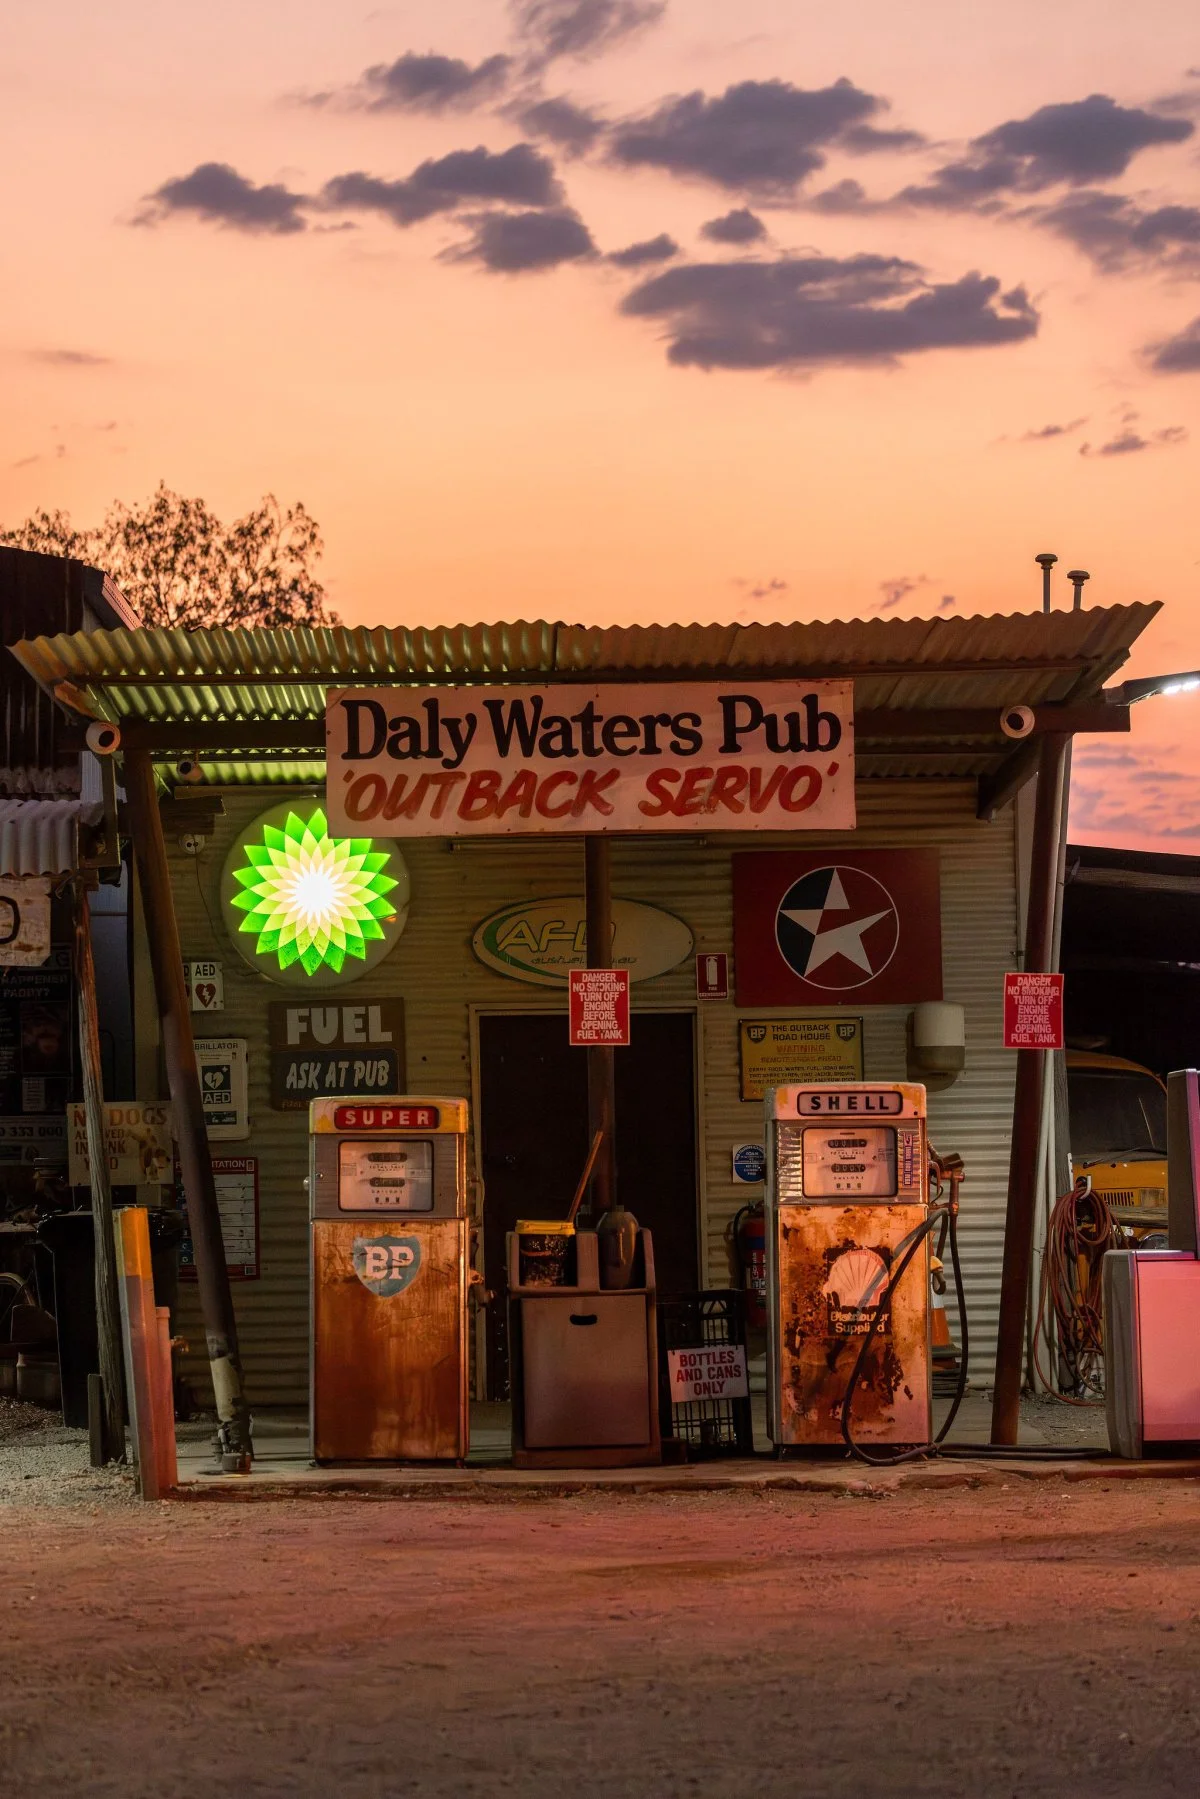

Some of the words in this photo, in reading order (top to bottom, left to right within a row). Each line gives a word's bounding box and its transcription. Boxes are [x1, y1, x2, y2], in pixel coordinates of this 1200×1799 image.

[340, 698, 477, 769] Daly
[483, 696, 703, 758] Waters
[718, 694, 842, 754] Pub
[342, 768, 620, 821] 'OUTBACK
[638, 761, 839, 817] SERVO'
[195, 964, 216, 976] AED
[582, 973, 616, 982] DANGER
[1017, 976, 1052, 986] DANGER
[573, 983, 585, 992] NO
[587, 982, 626, 992] SMOKING
[1008, 986, 1020, 995] NO
[1022, 986, 1059, 996] SMOKING
[579, 992, 602, 1001] TURN
[604, 992, 619, 1001] OFF
[1013, 996, 1036, 1005] TURN
[1038, 996, 1053, 1005] OFF
[584, 1001, 615, 1010] ENGINE
[1018, 1005, 1049, 1014] ENGINE
[583, 1011, 616, 1020] BEFORE
[1017, 1014, 1049, 1024] BEFORE
[286, 1005, 393, 1045] FUEL
[581, 1020, 618, 1030] OPENING
[1015, 1024, 1052, 1033] OPENING
[577, 1030, 598, 1039] FUEL
[599, 1030, 622, 1039] TANK
[750, 1027, 765, 1039] BP
[773, 1033, 797, 1041] ROAD
[801, 1032, 831, 1040] HOUSE
[840, 1026, 855, 1038] BP
[1011, 1033, 1032, 1043] FUEL
[1034, 1034, 1056, 1043] TANK
[195, 1042, 238, 1051] BRILLATOR
[776, 1044, 825, 1053] WARNING
[286, 1062, 321, 1090] ASK
[325, 1061, 349, 1088] AT
[353, 1059, 390, 1088] PUB
[204, 1093, 231, 1104] AED
[810, 1096, 889, 1111] SHELL
[73, 1110, 86, 1127] N
[109, 1107, 167, 1126] DOGS
[345, 1109, 429, 1125] SUPER
[364, 1246, 414, 1280] BP
[830, 1311, 890, 1322] Distribur
[835, 1322, 885, 1335] Supplid
[679, 1350, 735, 1367] BOTTLES
[676, 1368, 703, 1383] AND
[707, 1364, 741, 1380] CANS
[693, 1380, 726, 1396] ONLY
